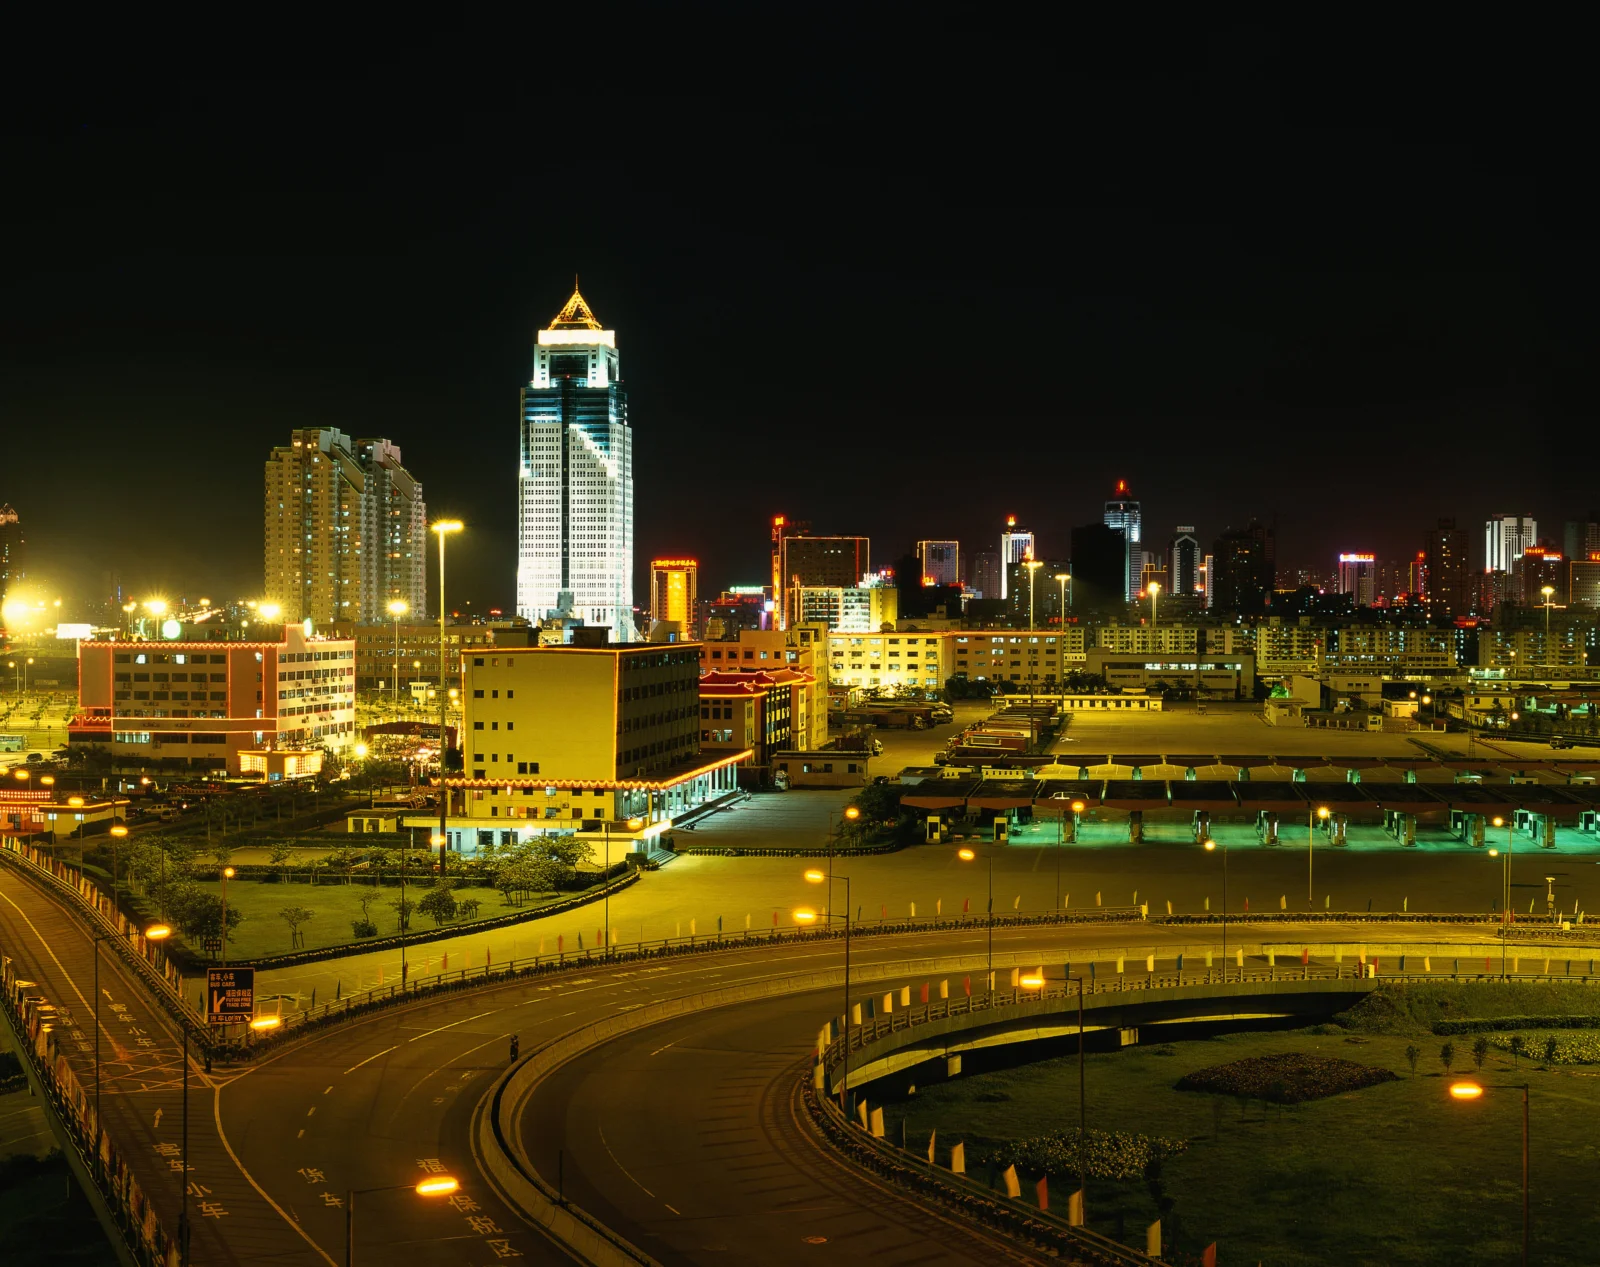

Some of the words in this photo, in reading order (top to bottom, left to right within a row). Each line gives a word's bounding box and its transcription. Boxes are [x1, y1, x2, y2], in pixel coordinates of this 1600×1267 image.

[128, 1026, 156, 1047] 小车
[152, 1142, 196, 1172] 客车
[186, 1181, 230, 1219] 小车
[297, 1168, 345, 1208] 货车
